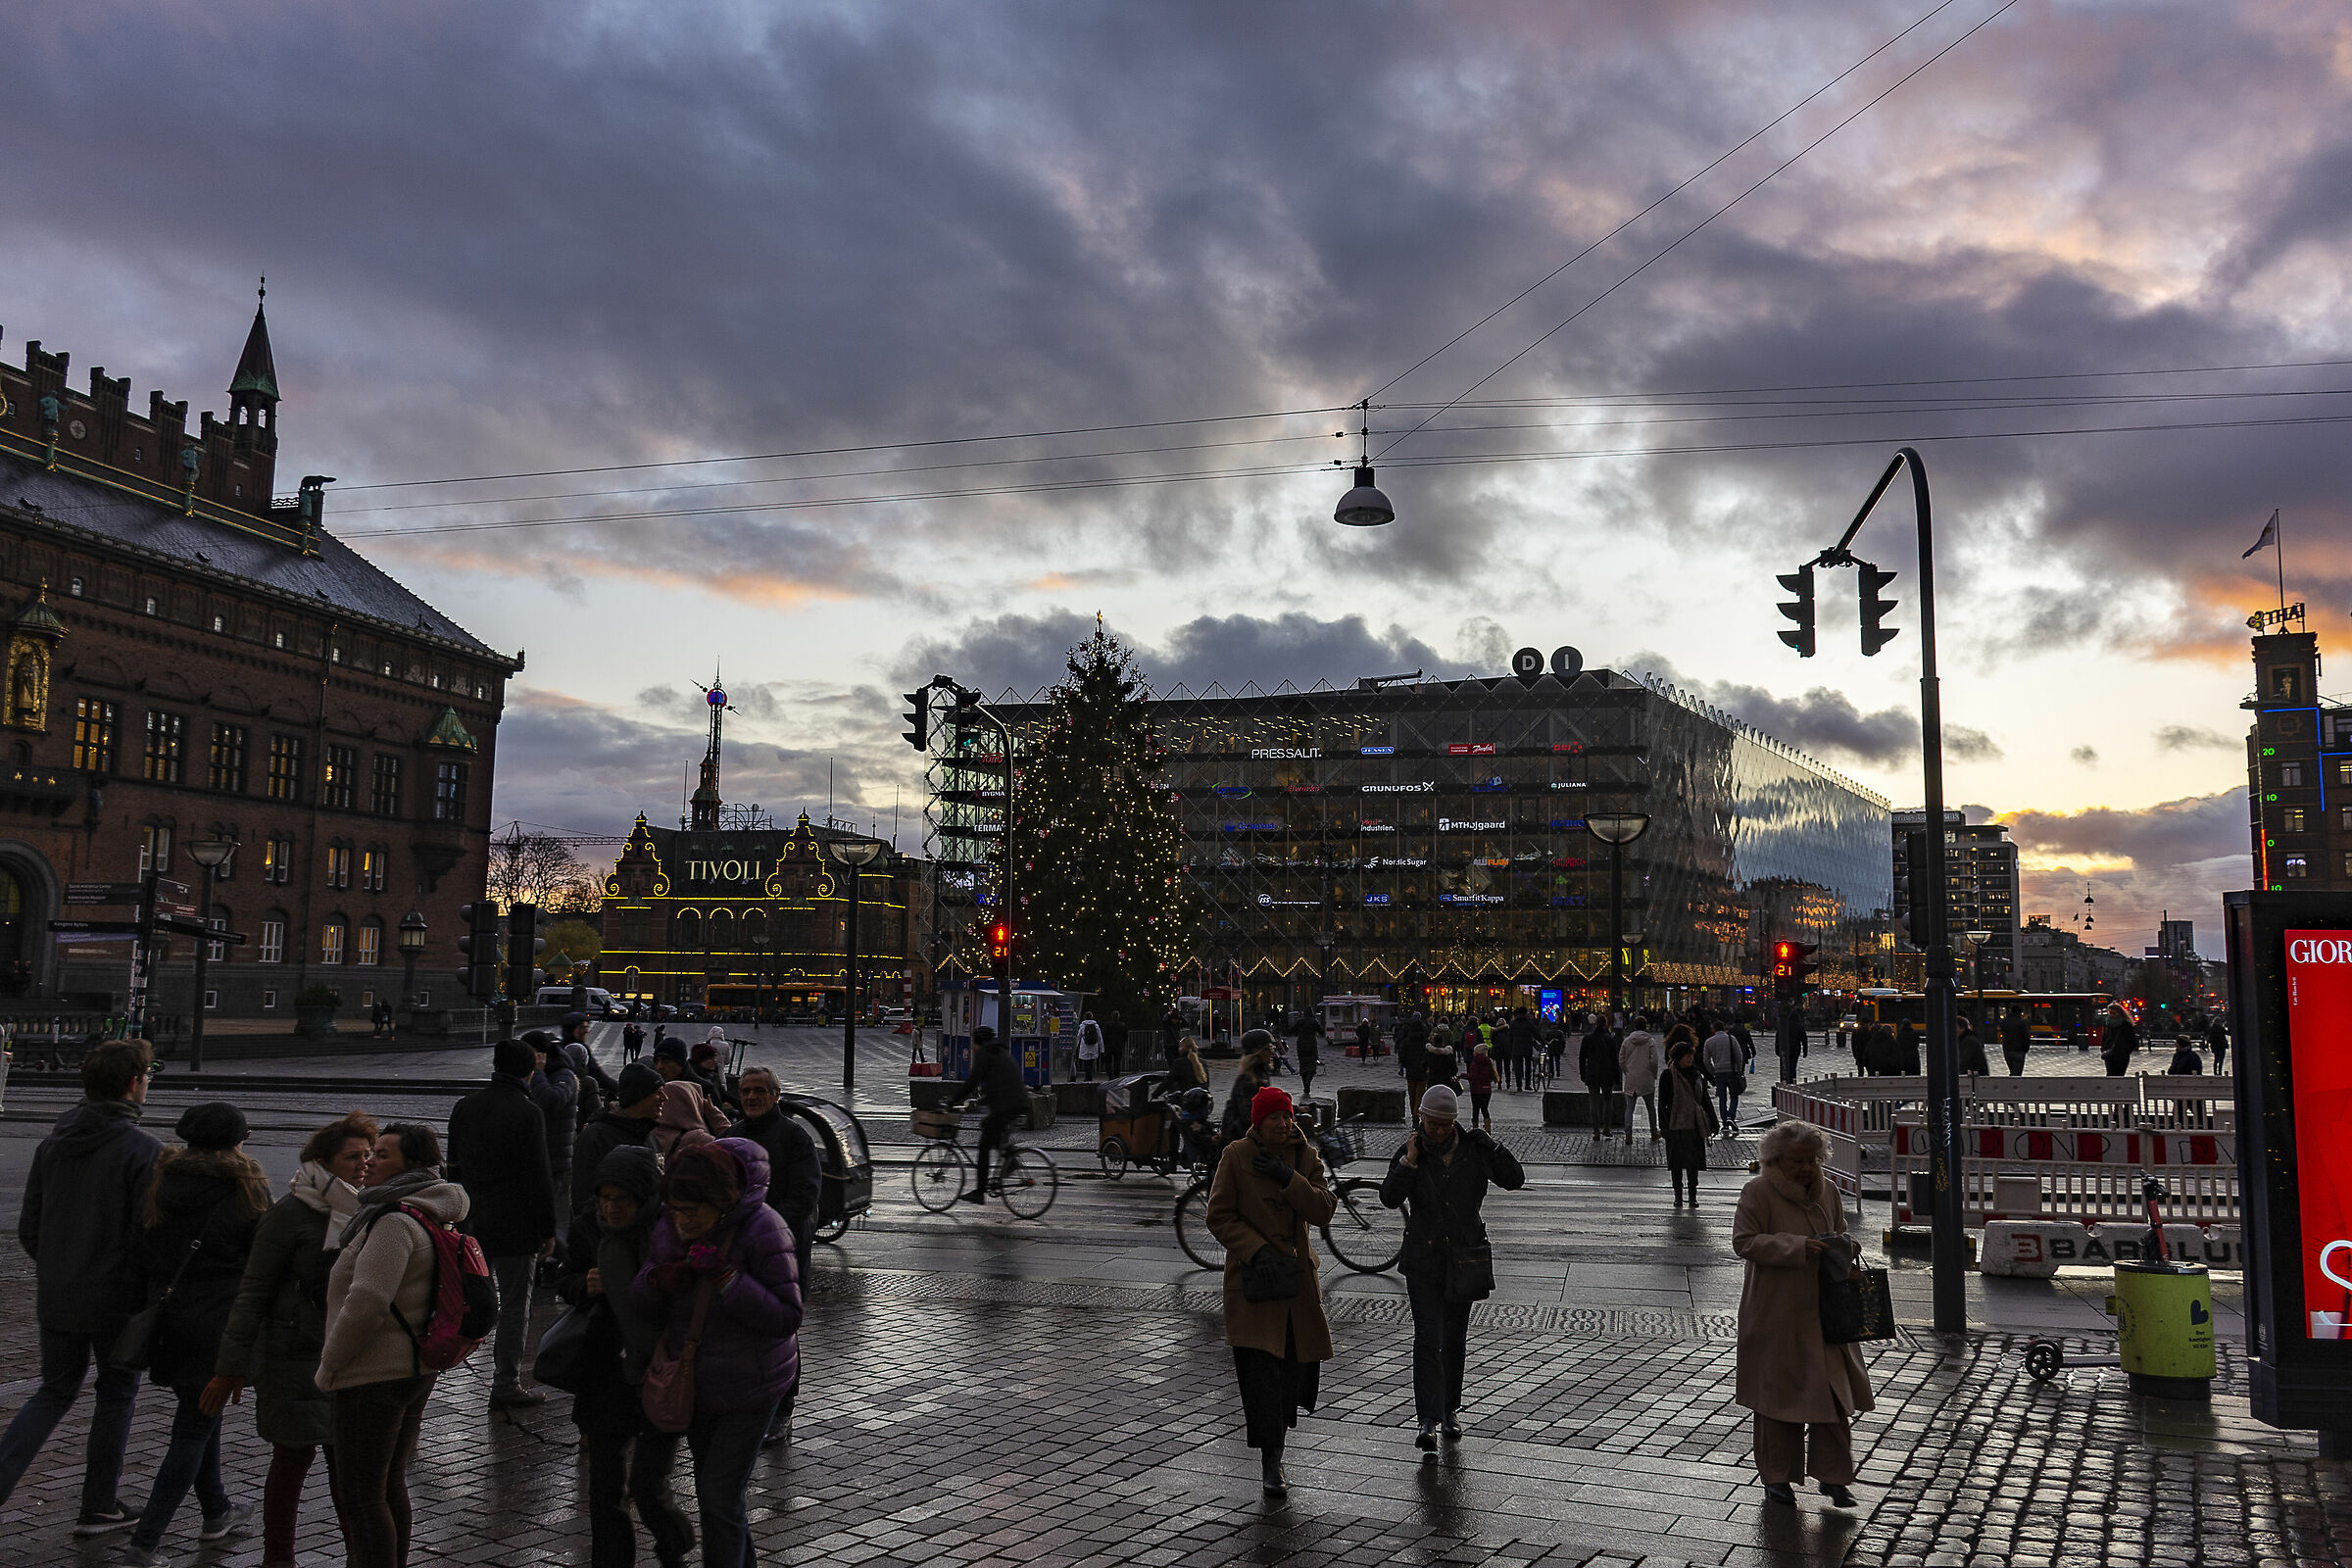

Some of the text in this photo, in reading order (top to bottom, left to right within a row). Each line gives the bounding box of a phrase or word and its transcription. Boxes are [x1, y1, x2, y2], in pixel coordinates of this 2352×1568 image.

[1522, 656, 1536, 670] D
[2262, 748, 2275, 757] 20
[2266, 794, 2278, 803] 10
[2267, 839, 2275, 848] 0
[1406, 858, 1427, 867] Sugar
[685, 859, 761, 881] TIVOLI
[1481, 894, 1504, 904] Kappa
[995, 947, 1006, 956] 21
[2289, 939, 2352, 963] GIOR
[1778, 965, 1791, 976] 21
[2049, 1239, 2242, 1263] BARLU
